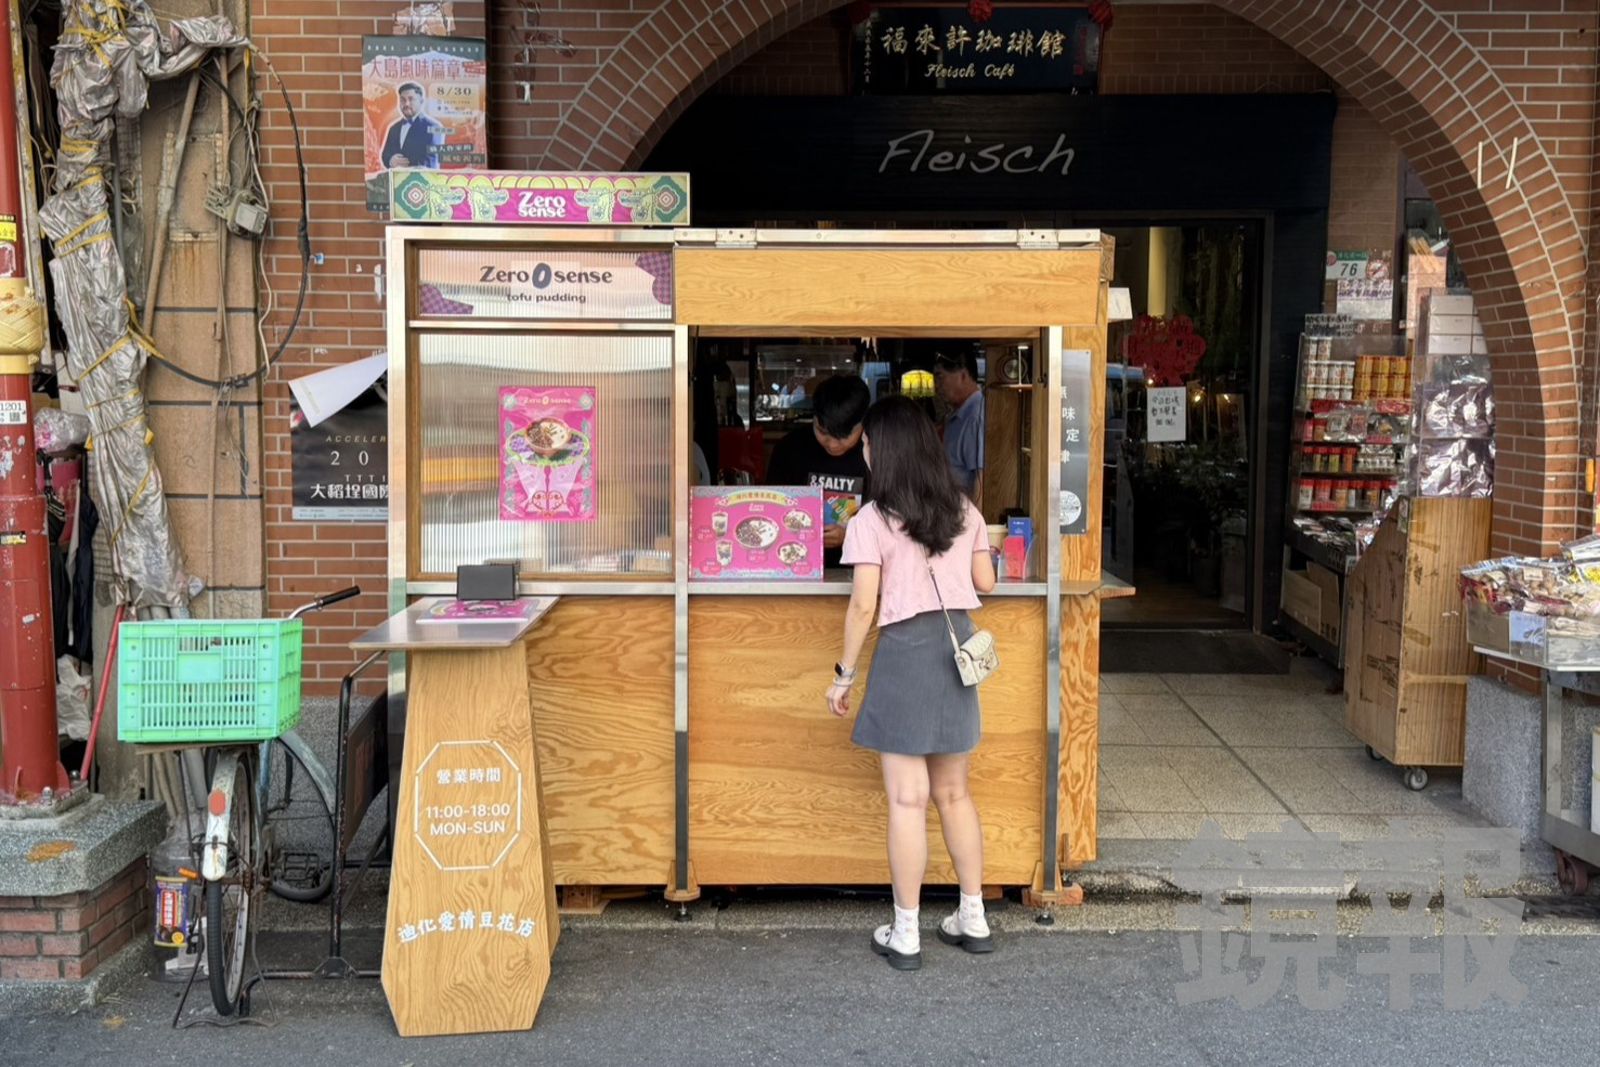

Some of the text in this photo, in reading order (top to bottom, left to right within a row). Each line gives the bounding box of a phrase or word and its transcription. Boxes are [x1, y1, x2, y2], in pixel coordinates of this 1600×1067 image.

[881, 24, 1066, 59] 福來許珈琲館
[924, 63, 976, 78] Fleisch
[436, 86, 473, 97] 8/30
[878, 129, 1075, 175] Fleisch
[518, 191, 566, 208] Zero
[518, 206, 566, 217] sense
[480, 265, 529, 283] Zero
[554, 270, 613, 283] sense
[1341, 263, 1358, 276] 76
[507, 293, 586, 304] tofu pudding
[810, 475, 855, 491] &SALTY
[436, 767, 501, 784] 營業時間
[425, 803, 511, 819] 11:00-18:00
[430, 821, 506, 836] MON-SUN
[398, 909, 535, 943] 迪化愛情豆花店
